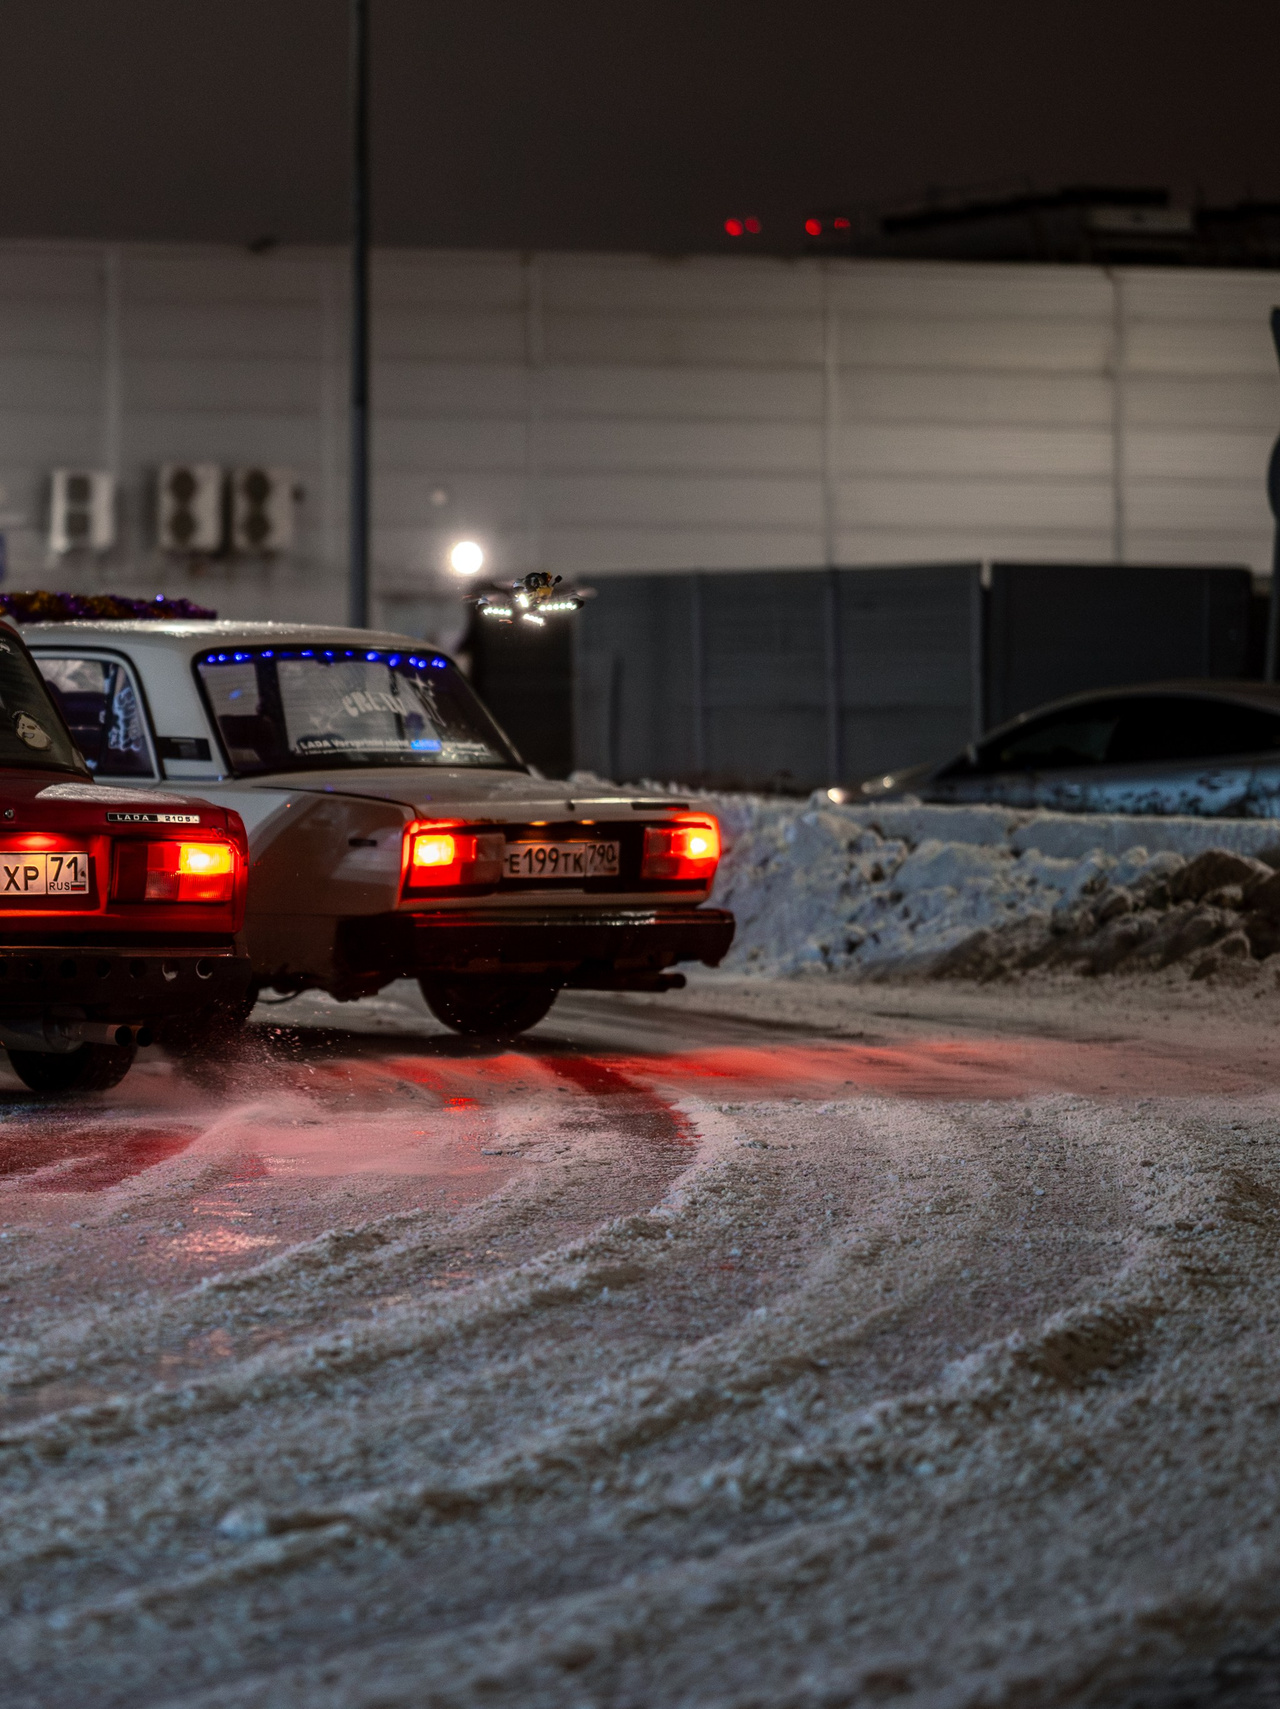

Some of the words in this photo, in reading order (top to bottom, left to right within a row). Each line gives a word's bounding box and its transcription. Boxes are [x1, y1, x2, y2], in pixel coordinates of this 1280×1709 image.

[116, 813, 150, 821] LADA
[587, 843, 617, 864] 790
[49, 856, 79, 882] 71
[48, 881, 71, 891] RUS
